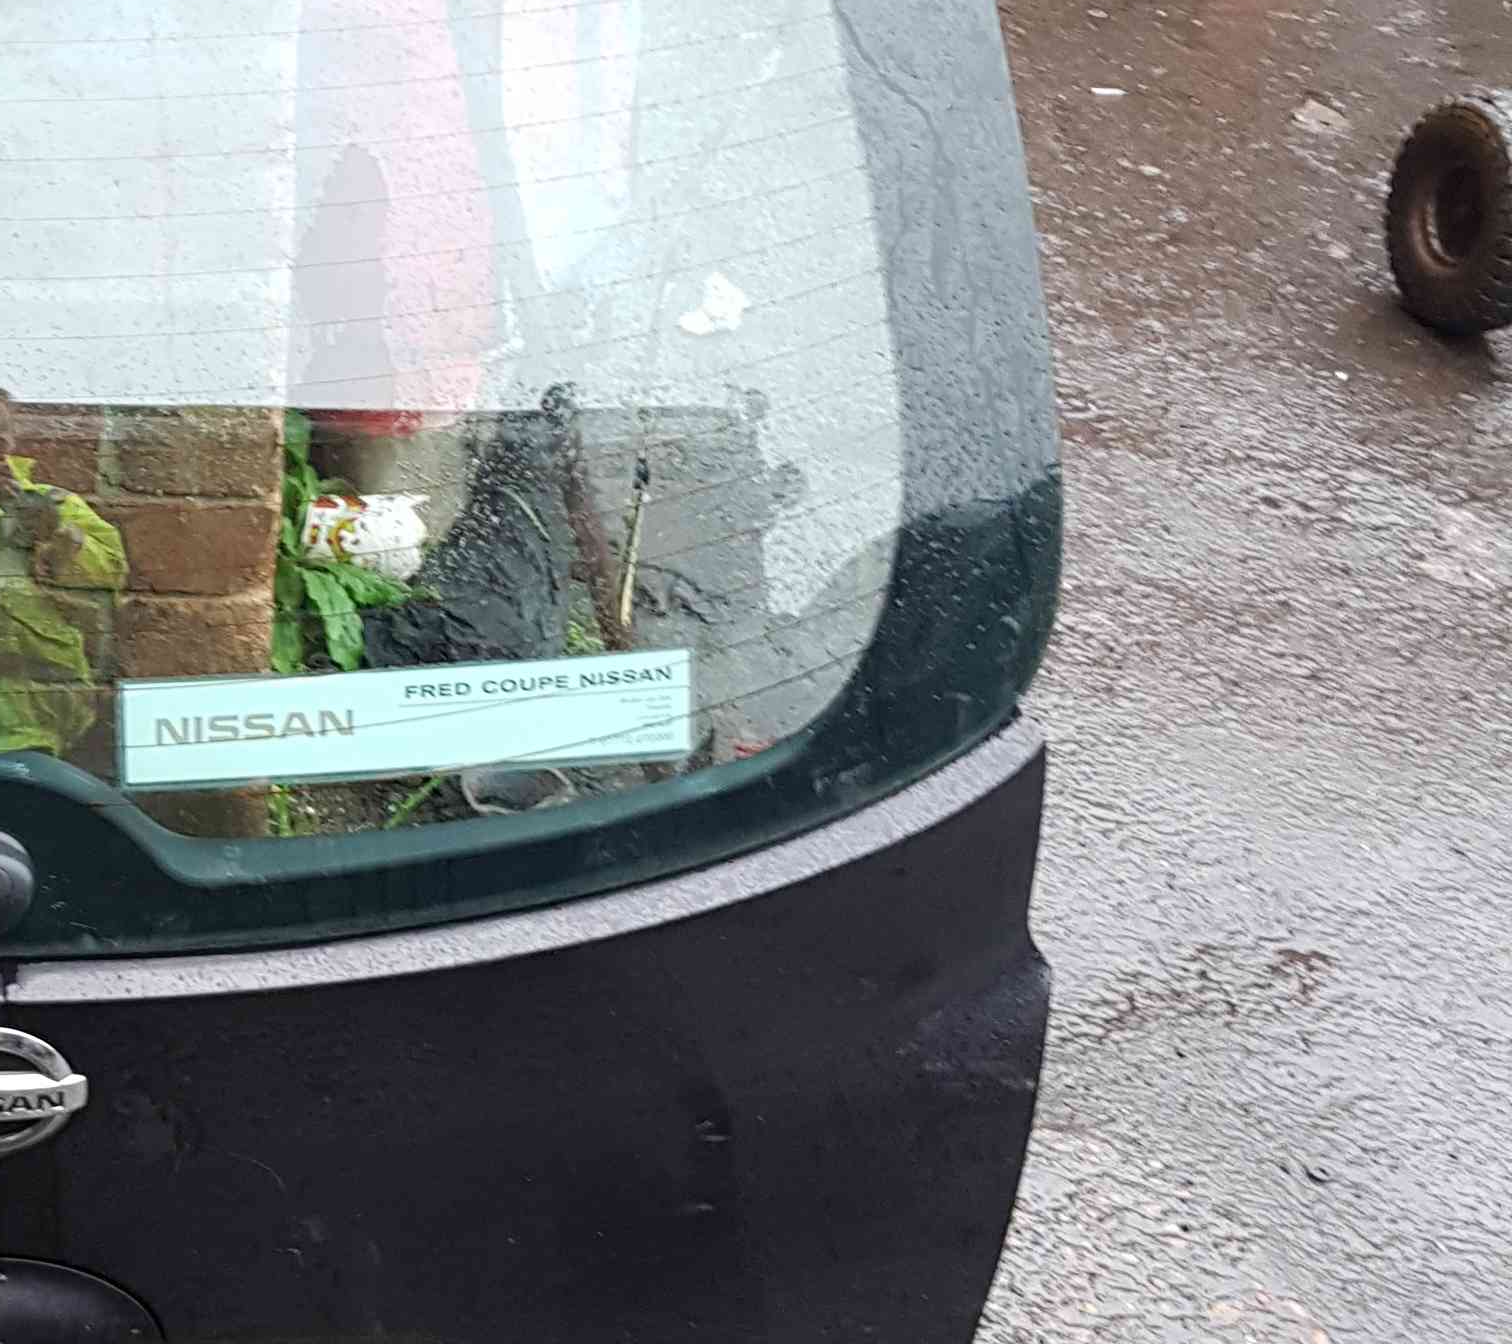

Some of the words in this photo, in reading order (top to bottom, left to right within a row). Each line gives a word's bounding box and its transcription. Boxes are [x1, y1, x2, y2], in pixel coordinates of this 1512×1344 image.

[405, 682, 471, 699] FRED
[481, 674, 569, 695] COUPE
[579, 666, 673, 688] NISSAN
[154, 709, 354, 746] NISSAN
